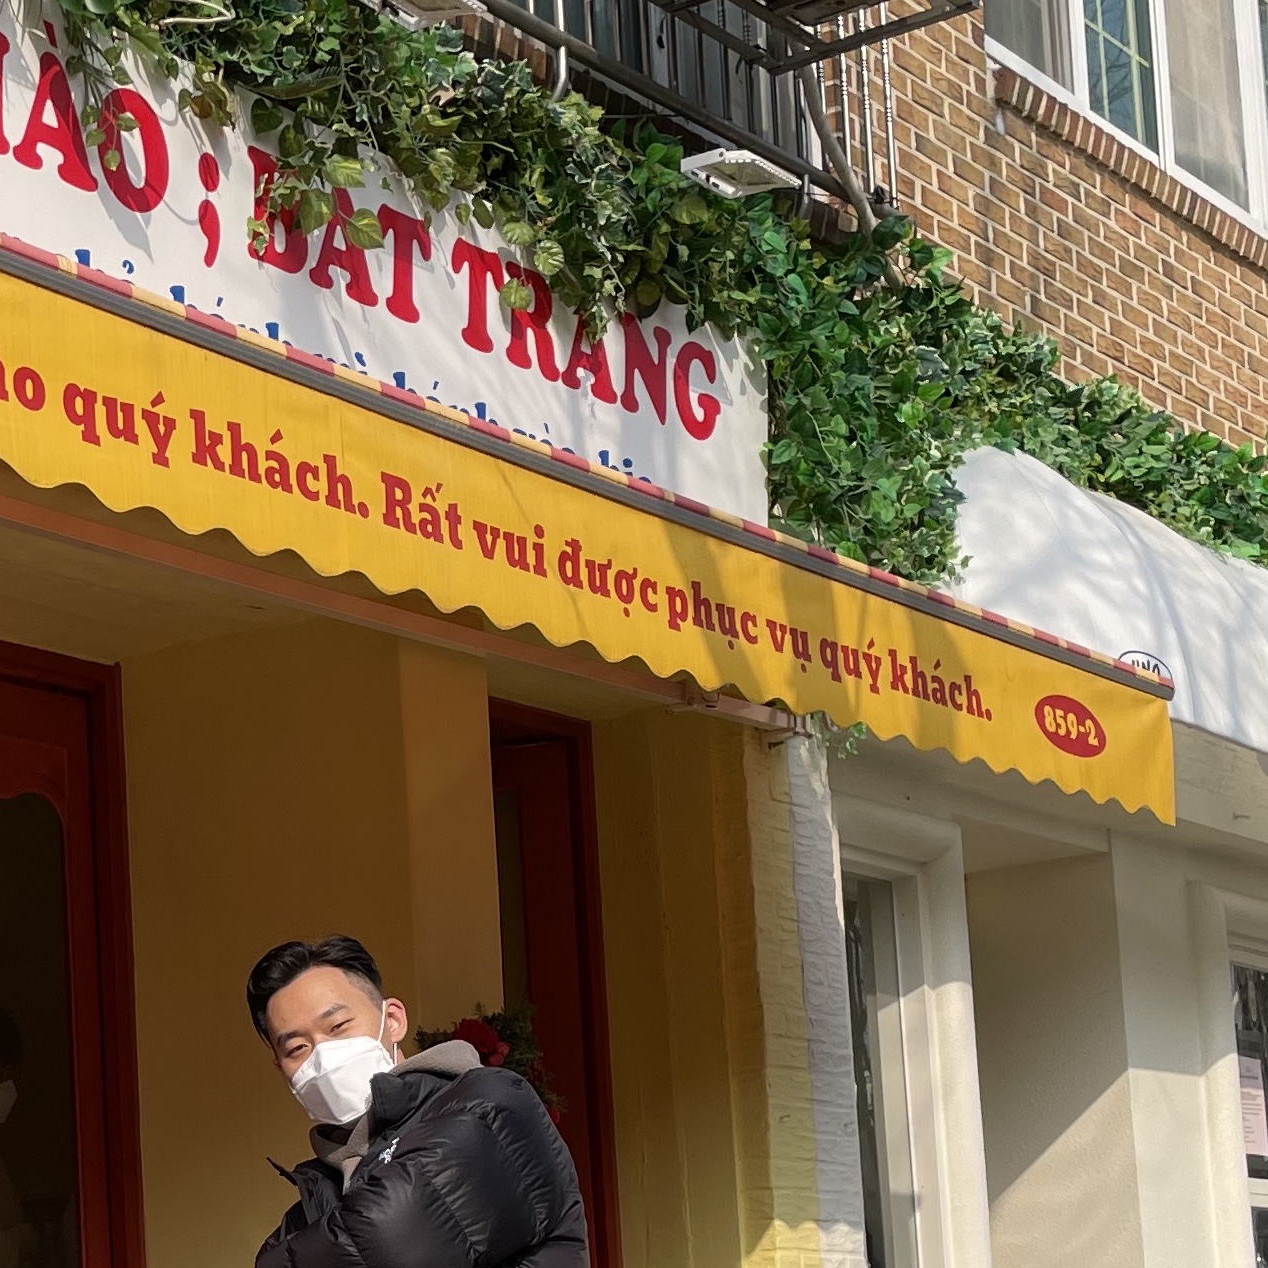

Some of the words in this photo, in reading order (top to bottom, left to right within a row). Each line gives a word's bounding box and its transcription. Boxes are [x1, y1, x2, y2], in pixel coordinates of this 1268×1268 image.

[62, 382, 177, 469] quý
[189, 408, 370, 519] khách.
[380, 471, 464, 550] Rất
[472, 520, 548, 578] vui
[557, 538, 659, 618] được
[665, 581, 759, 651] phục
[765, 618, 812, 675] vụ
[819, 635, 882, 696] quý
[887, 649, 993, 722] khách.
[1043, 704, 1099, 748] 859-2
